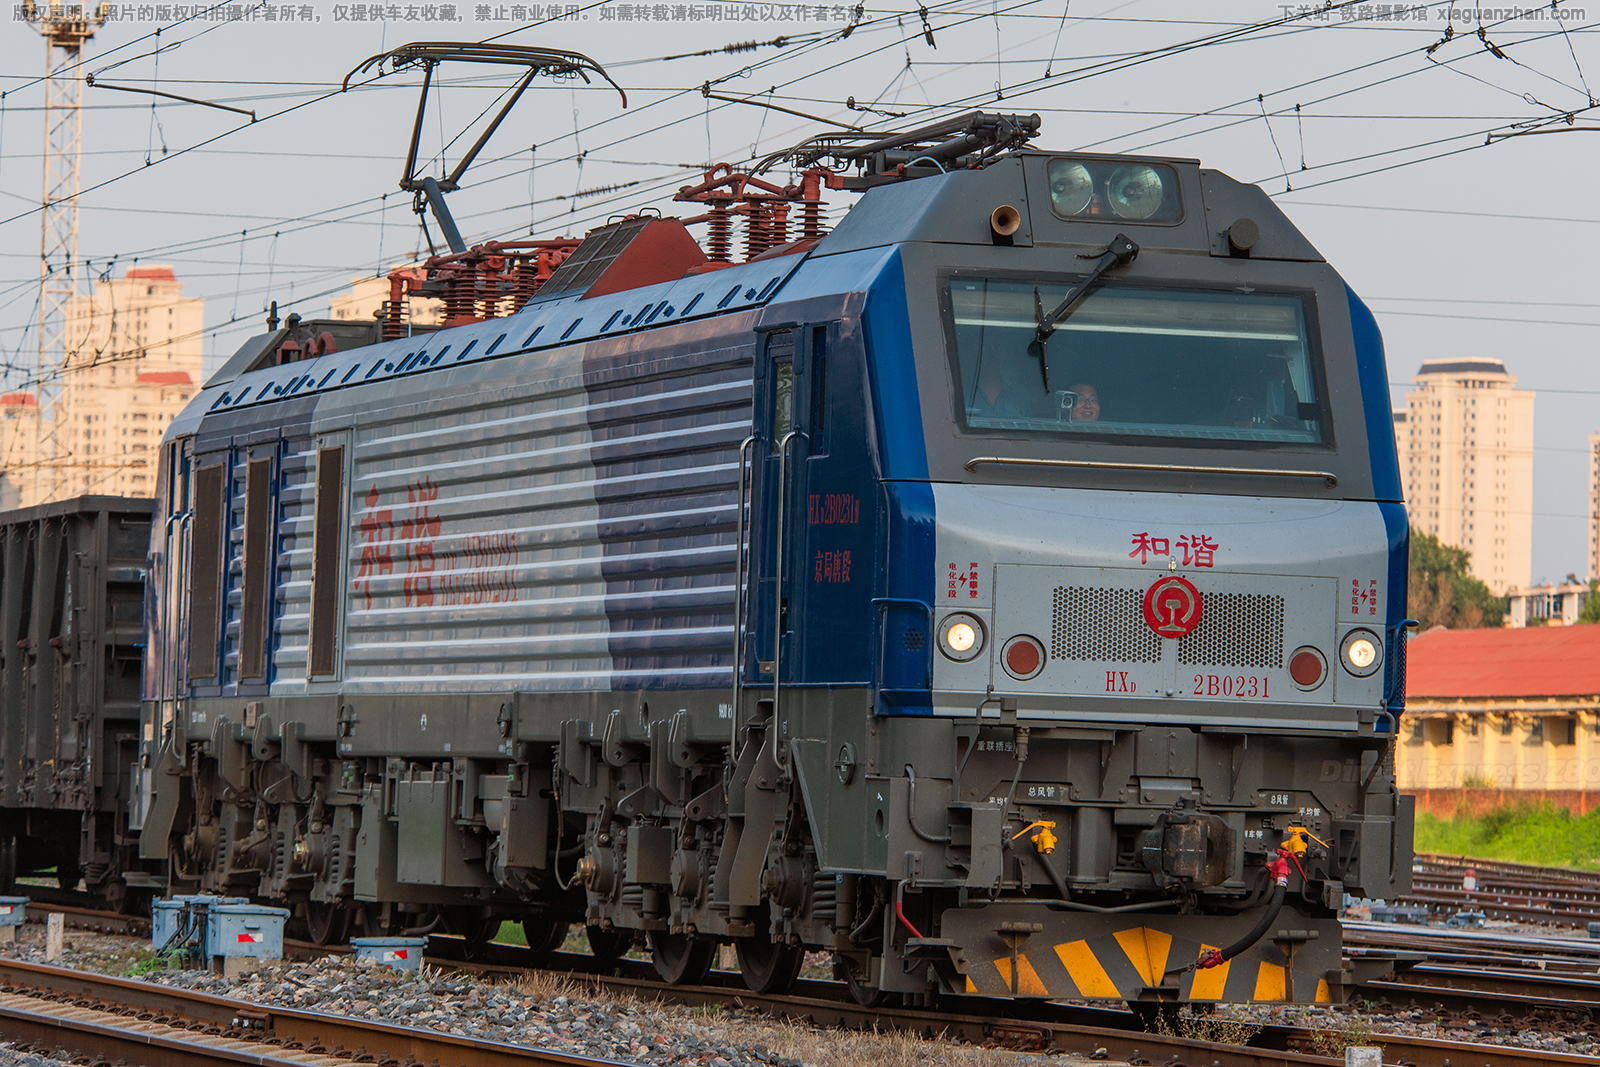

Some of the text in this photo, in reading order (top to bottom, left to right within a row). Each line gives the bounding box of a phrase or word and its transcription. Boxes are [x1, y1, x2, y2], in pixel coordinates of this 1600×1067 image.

[354, 475, 442, 610] 和谐
[1128, 532, 1219, 568] 和谐
[814, 550, 852, 583] 京局唐段
[948, 562, 957, 598] 电化区段
[969, 562, 978, 598] 严禁攀登
[1105, 671, 1270, 699] HXD 2B0231
[977, 740, 1013, 752] 重联插座
[1028, 786, 1055, 798] 总风管
[1270, 794, 1289, 805] 总风管
[1299, 807, 1321, 817] 平均管
